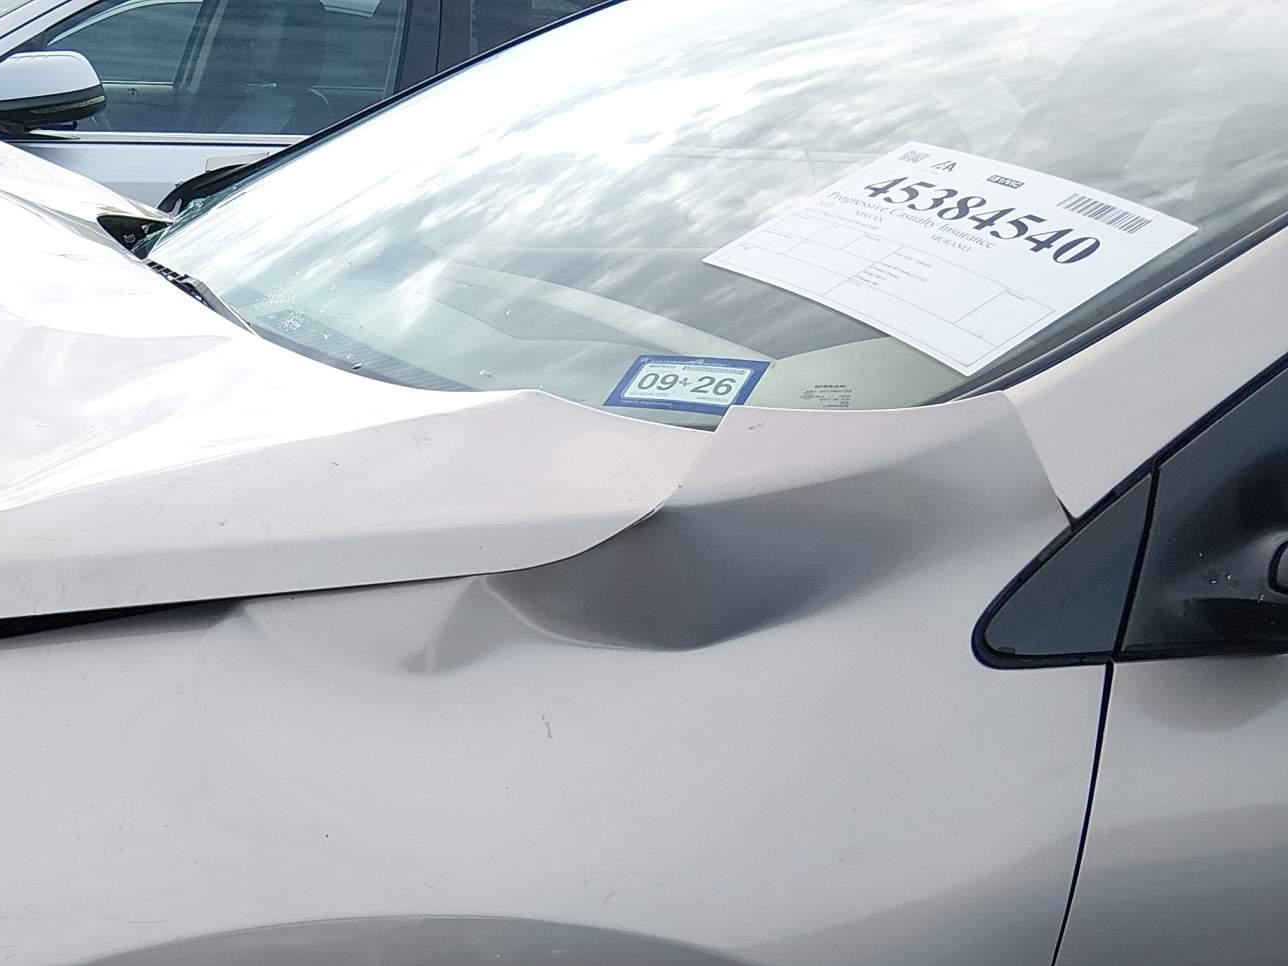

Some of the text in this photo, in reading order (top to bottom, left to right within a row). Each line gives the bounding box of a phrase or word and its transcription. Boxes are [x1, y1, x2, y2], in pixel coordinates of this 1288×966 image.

[827, 191, 889, 212] Progressive
[889, 208, 936, 229] Casualty
[937, 223, 996, 249] Insurance
[864, 176, 1101, 264] 45384540
[636, 372, 737, 396] 09 26
